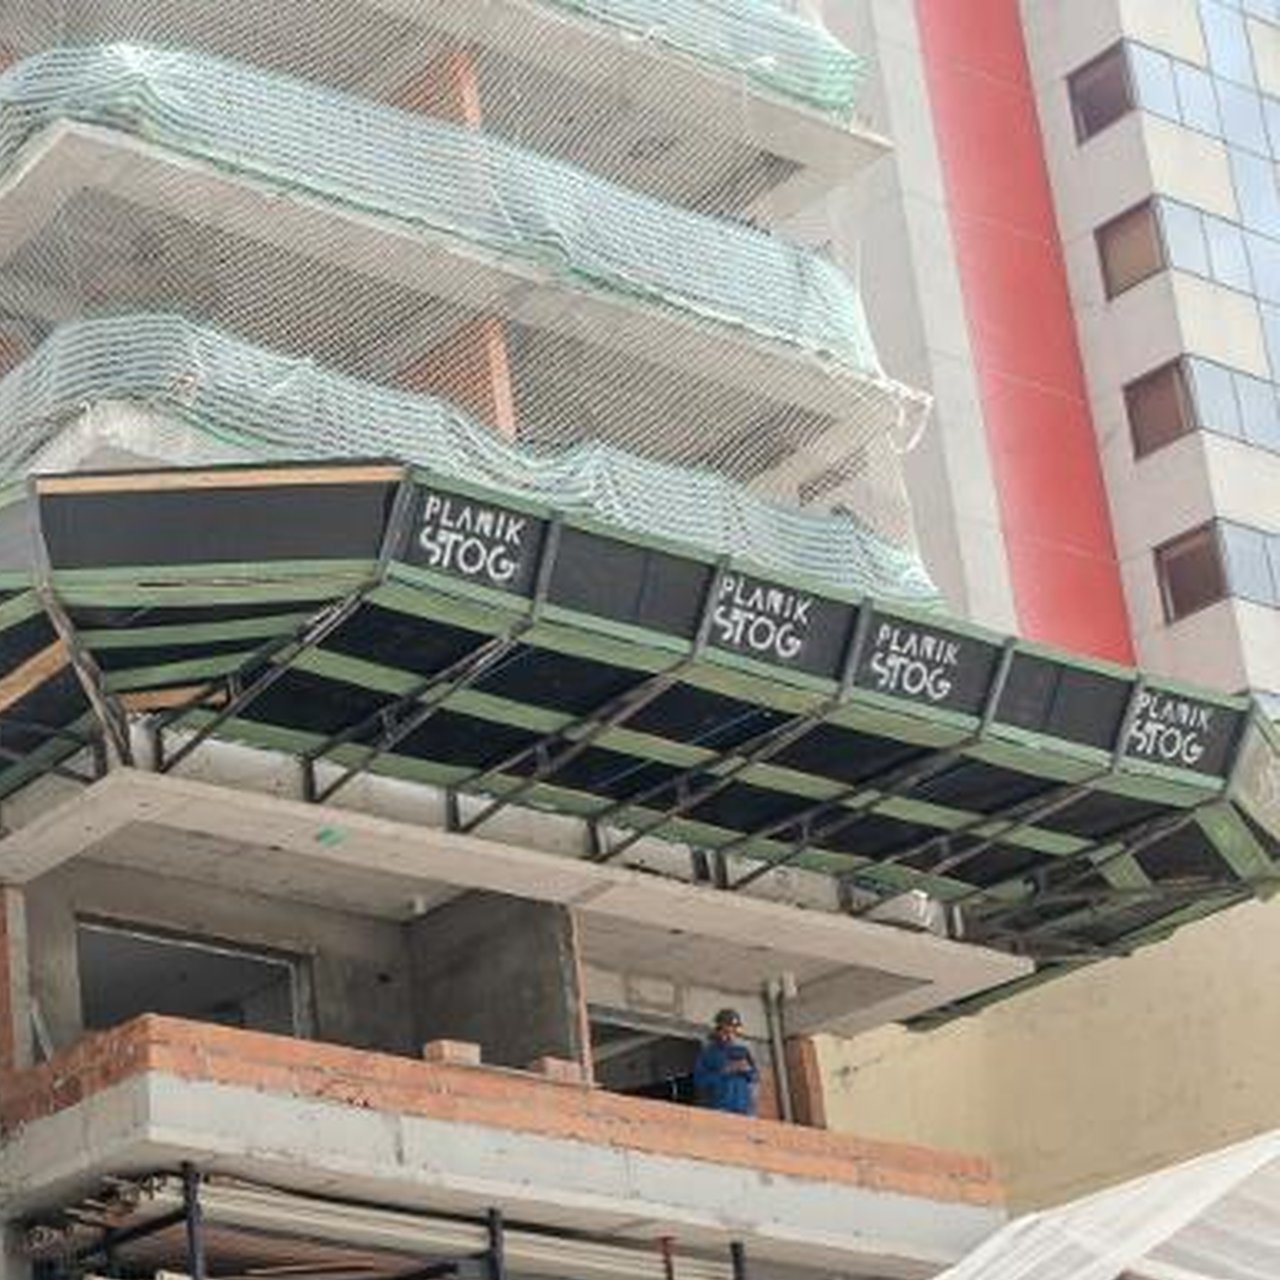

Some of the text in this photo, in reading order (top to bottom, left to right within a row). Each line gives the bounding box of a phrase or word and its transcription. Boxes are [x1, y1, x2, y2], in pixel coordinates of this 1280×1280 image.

[420, 526, 517, 580] STOG
[714, 605, 801, 658] STOG
[871, 651, 952, 700] STOG
[1129, 720, 1204, 764] STOG
